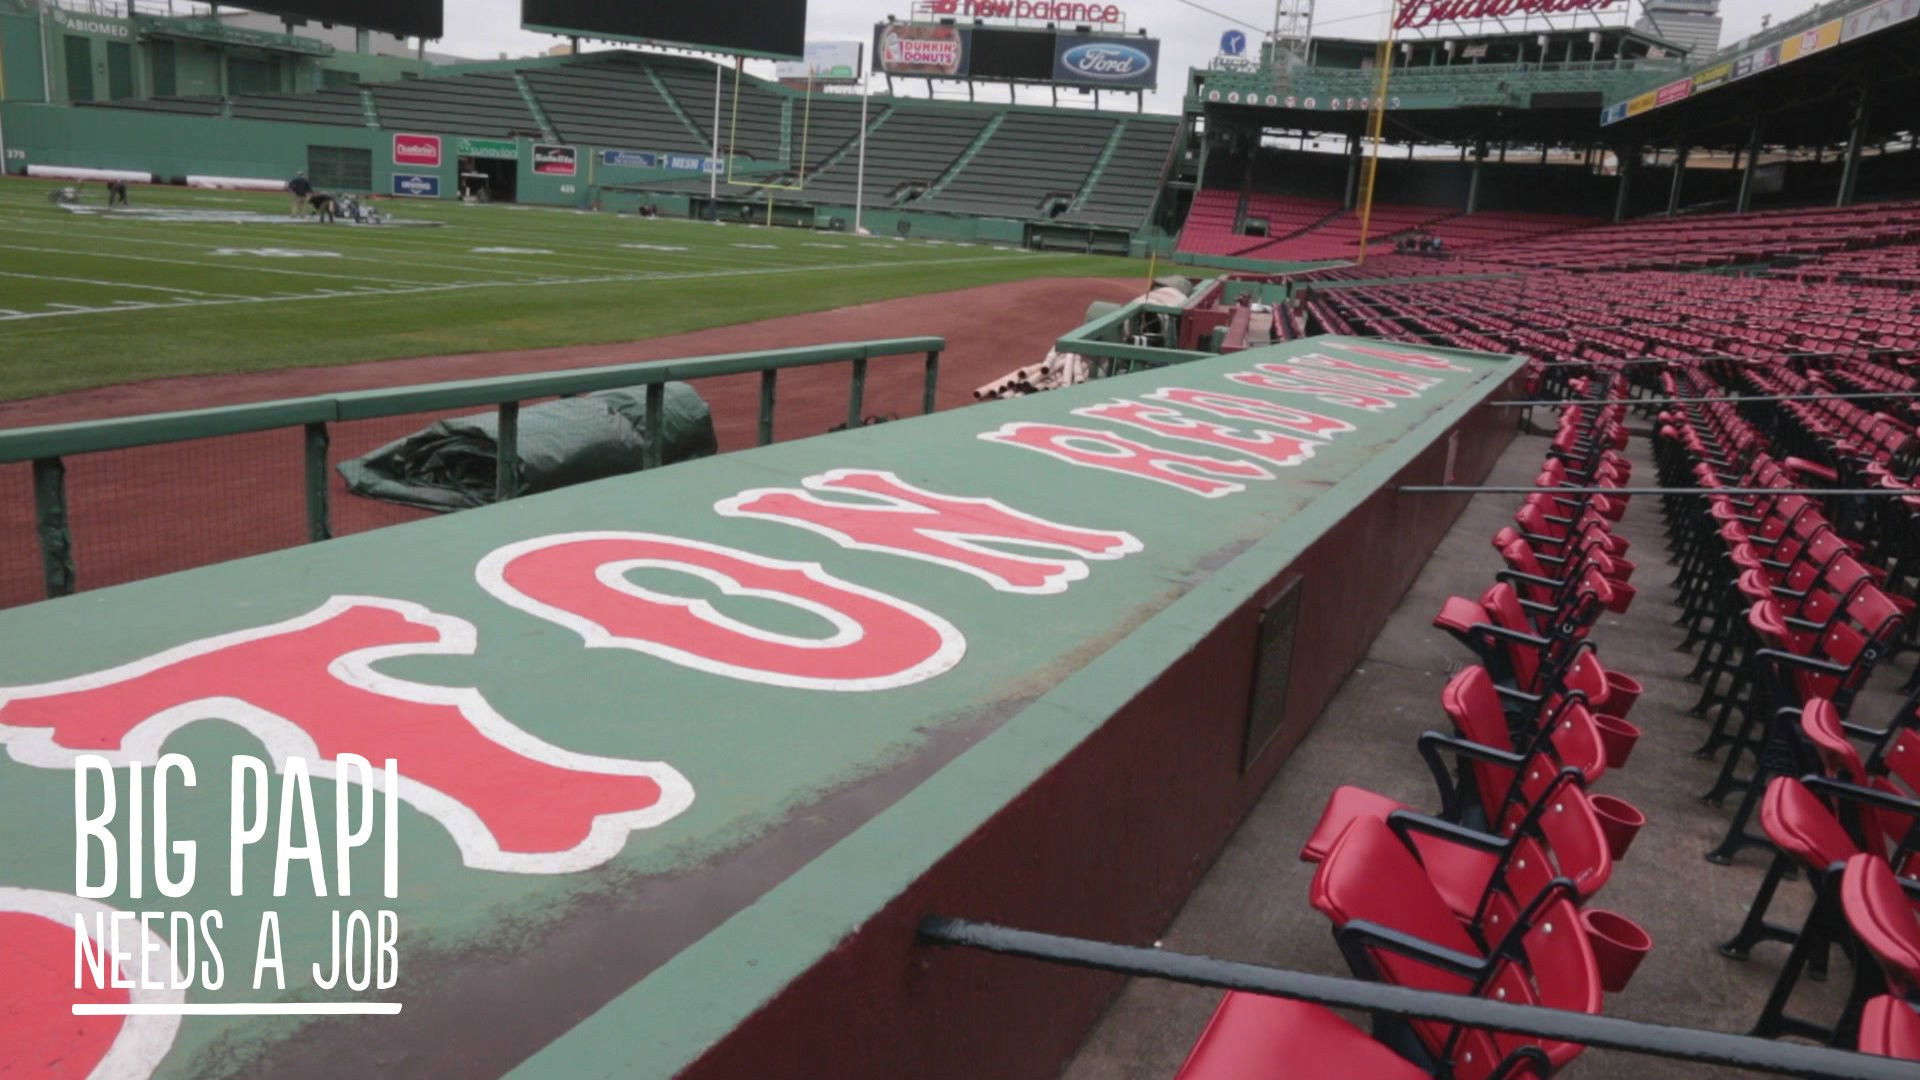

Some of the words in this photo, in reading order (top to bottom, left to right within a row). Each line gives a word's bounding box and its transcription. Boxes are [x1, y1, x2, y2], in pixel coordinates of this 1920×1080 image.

[67, 18, 128, 37] ABIOMED
[904, 51, 953, 65] DONUTS
[1079, 48, 1132, 73] Ford
[977, 387, 1357, 498] RED
[1223, 353, 1446, 412] SOX
